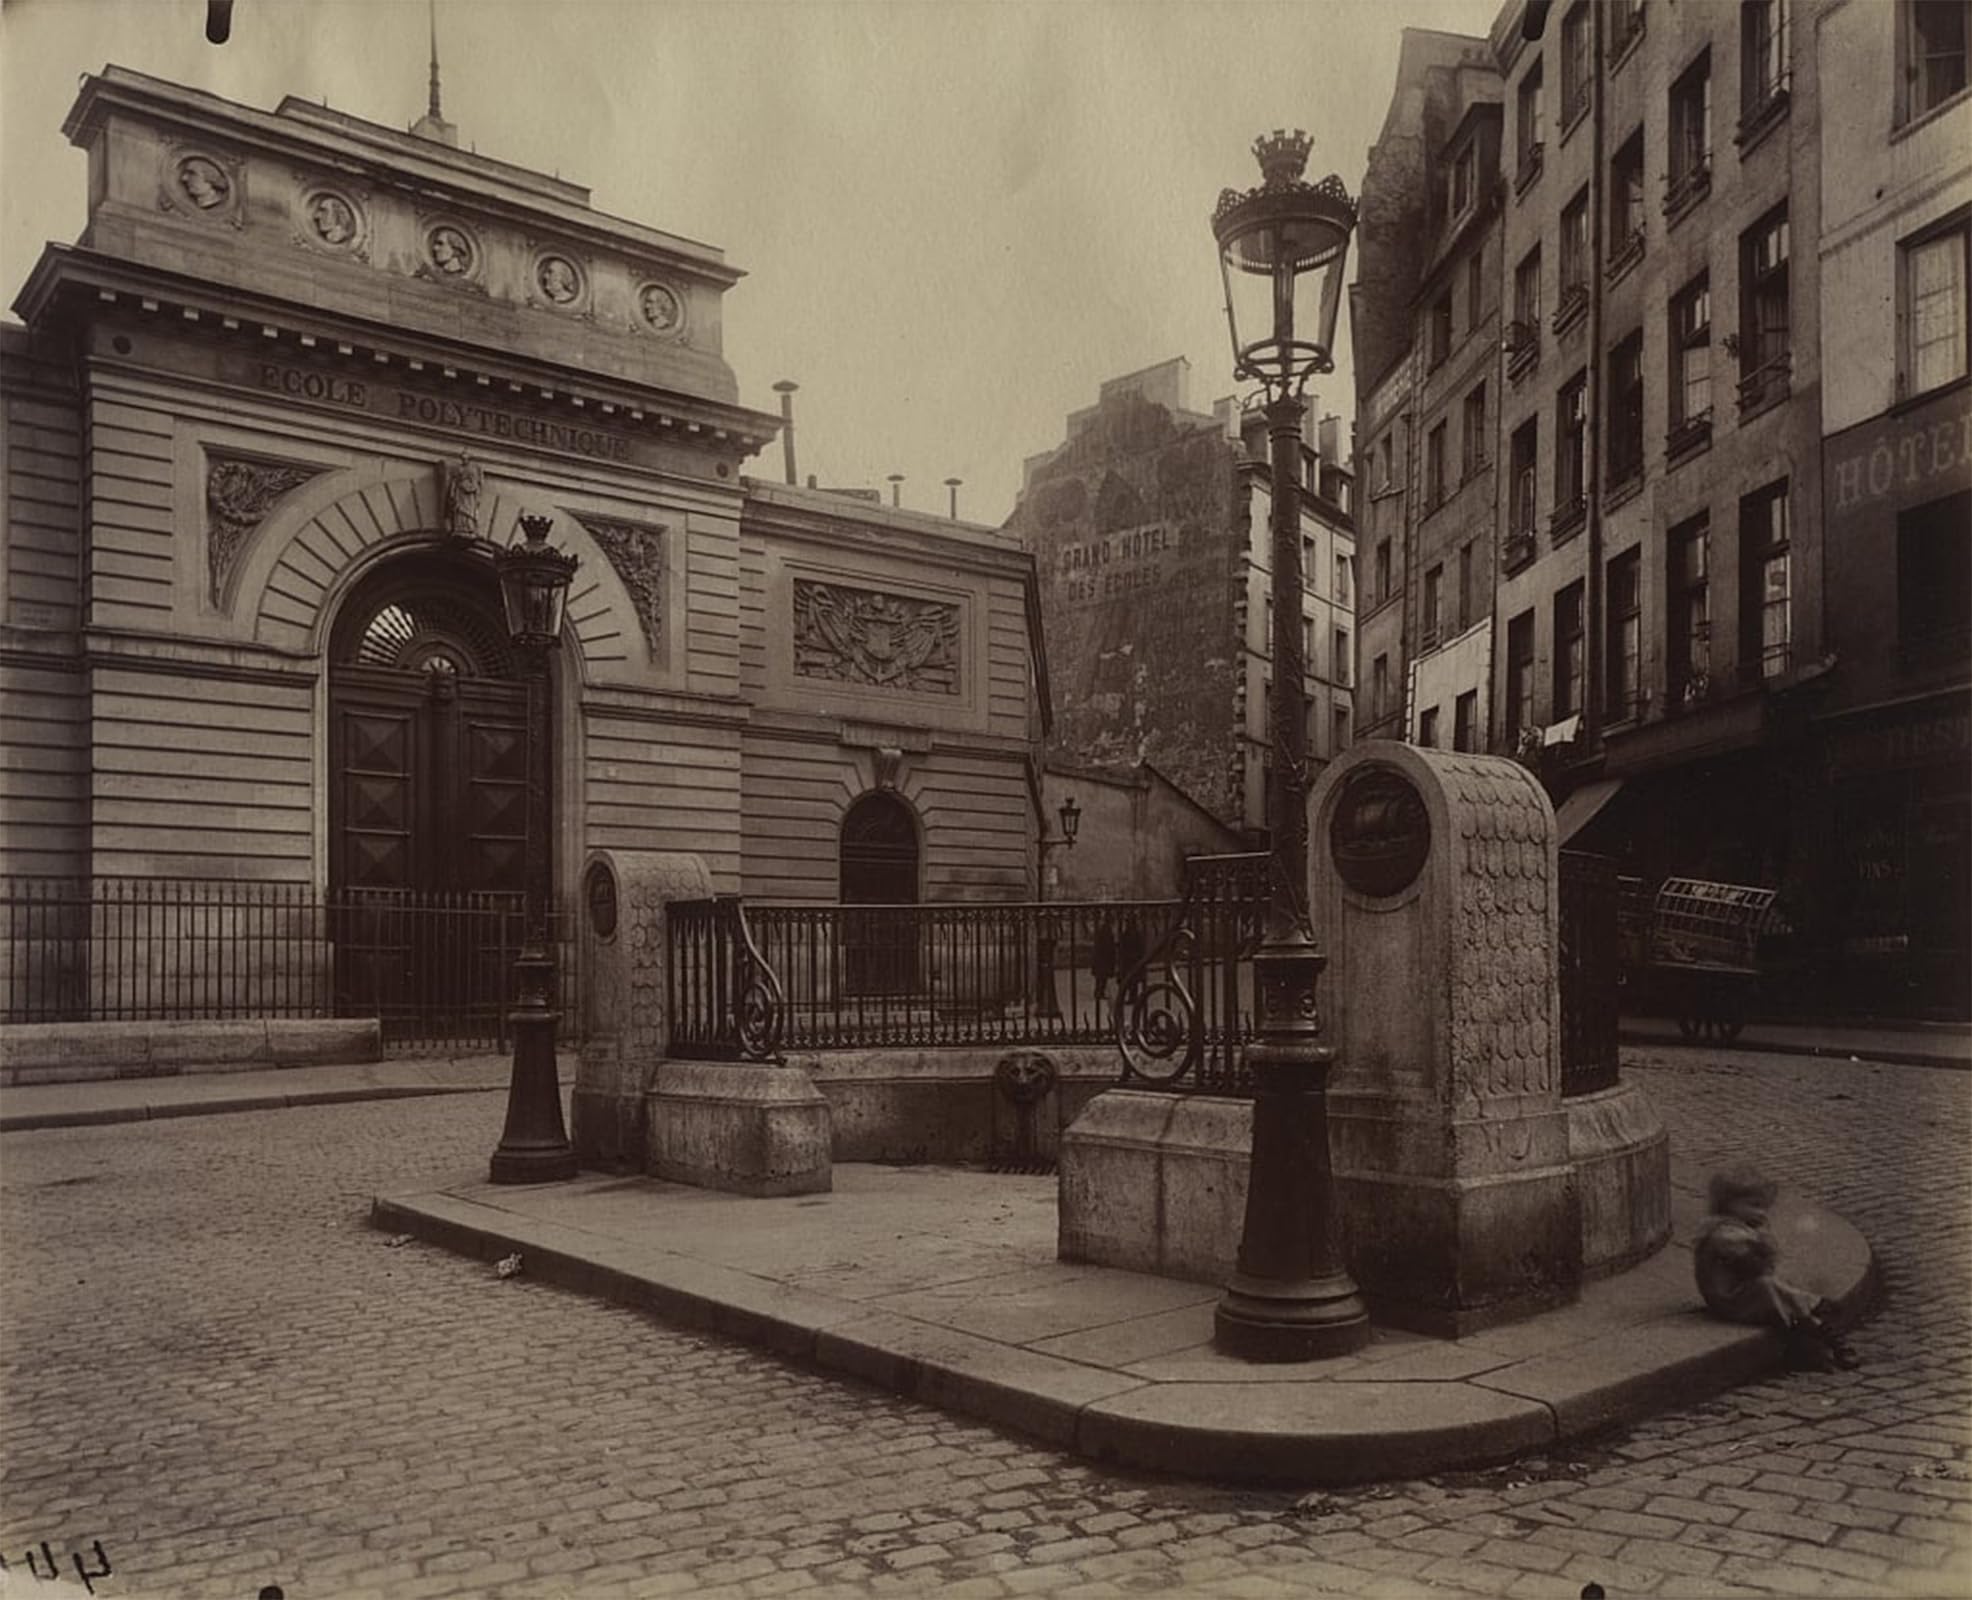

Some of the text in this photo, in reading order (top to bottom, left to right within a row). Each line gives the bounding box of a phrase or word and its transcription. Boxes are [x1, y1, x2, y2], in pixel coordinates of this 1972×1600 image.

[260, 363, 632, 460] ECOLE POLYTECHNIQUE
[1063, 541, 1111, 575] GRAND
[1068, 579, 1095, 602] DES
